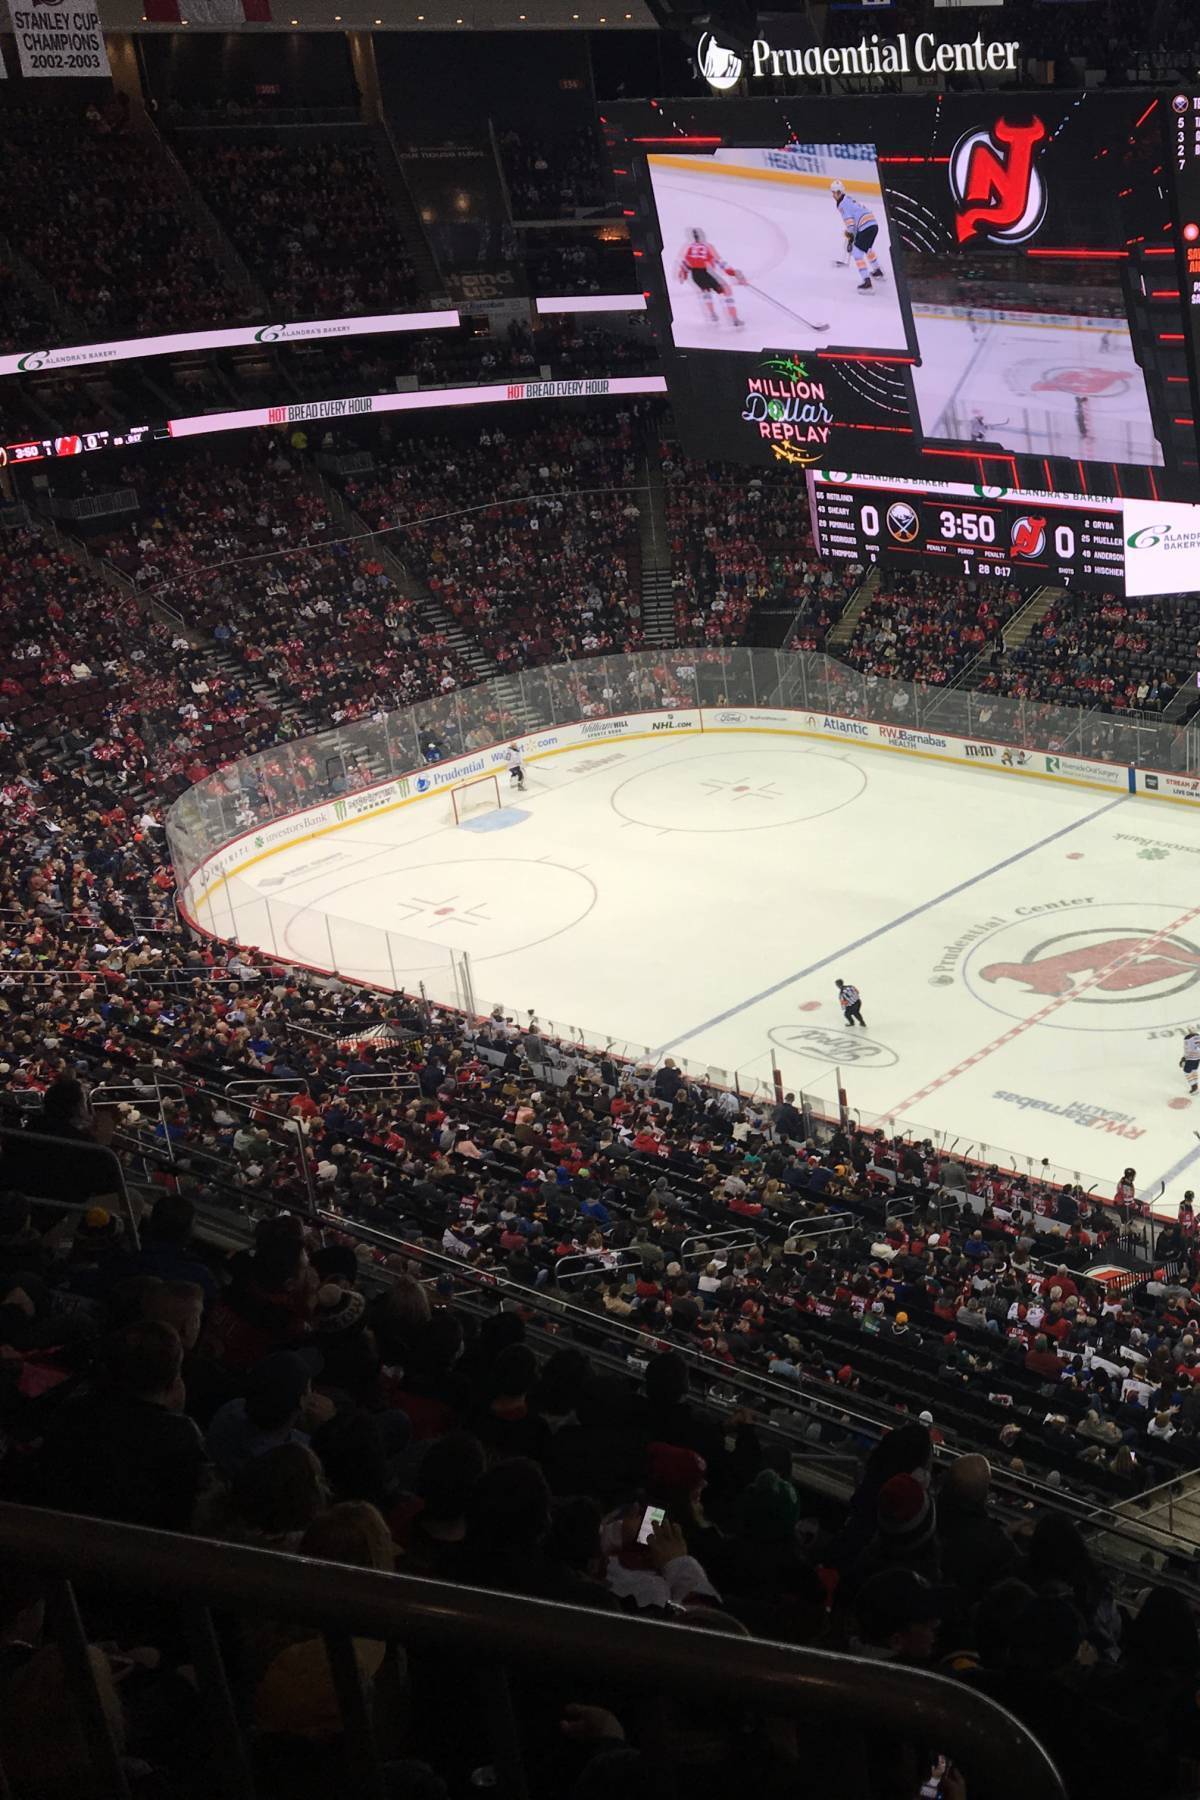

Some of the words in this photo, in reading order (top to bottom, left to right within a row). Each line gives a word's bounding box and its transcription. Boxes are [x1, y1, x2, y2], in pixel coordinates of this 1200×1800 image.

[14, 11, 69, 30] STANLEY
[73, 12, 98, 30] CUP
[23, 33, 100, 51] CHAMPIONS
[30, 54, 100, 68] 2002-2003
[752, 34, 910, 77] Prudential
[914, 32, 1019, 72] Center
[1178, 117, 1184, 128] 5
[1178, 132, 1184, 142] 3
[1178, 145, 1184, 156] 2
[1179, 160, 1185, 170] 7
[323, 325, 351, 335] BAKERY
[88, 350, 117, 360] BAKERY
[507, 385, 523, 400] HOT
[526, 383, 555, 398] BREAD
[557, 381, 583, 396] EVERY
[585, 380, 609, 395] HOUR
[748, 378, 824, 400] MILLION
[268, 408, 286, 423] HOT
[288, 403, 318, 421] BREAD
[319, 400, 347, 418] EVERY
[349, 398, 372, 414] HOUR
[759, 422, 830, 443] REPLAY
[1073, 494, 1115, 504] BAKERY
[860, 505, 879, 536] 0
[939, 511, 995, 543] 3:50
[926, 544, 946, 552] PENALTY
[1055, 526, 1075, 558] 0
[1093, 536, 1123, 546] MUELLER
[985, 551, 1005, 559] PENALTY
[1094, 552, 1124, 562] ANDERSON
[963, 560, 970, 574] 1
[1064, 577, 1069, 586] 7
[824, 717, 869, 736] Atlantic
[889, 738, 917, 750] HEALTH
[433, 759, 485, 785] Prudential
[1166, 778, 1190, 788] STREAM
[933, 916, 1007, 972] Prudential
[1015, 896, 1095, 916] Center
[1068, 1101, 1136, 1124] HEALTH
